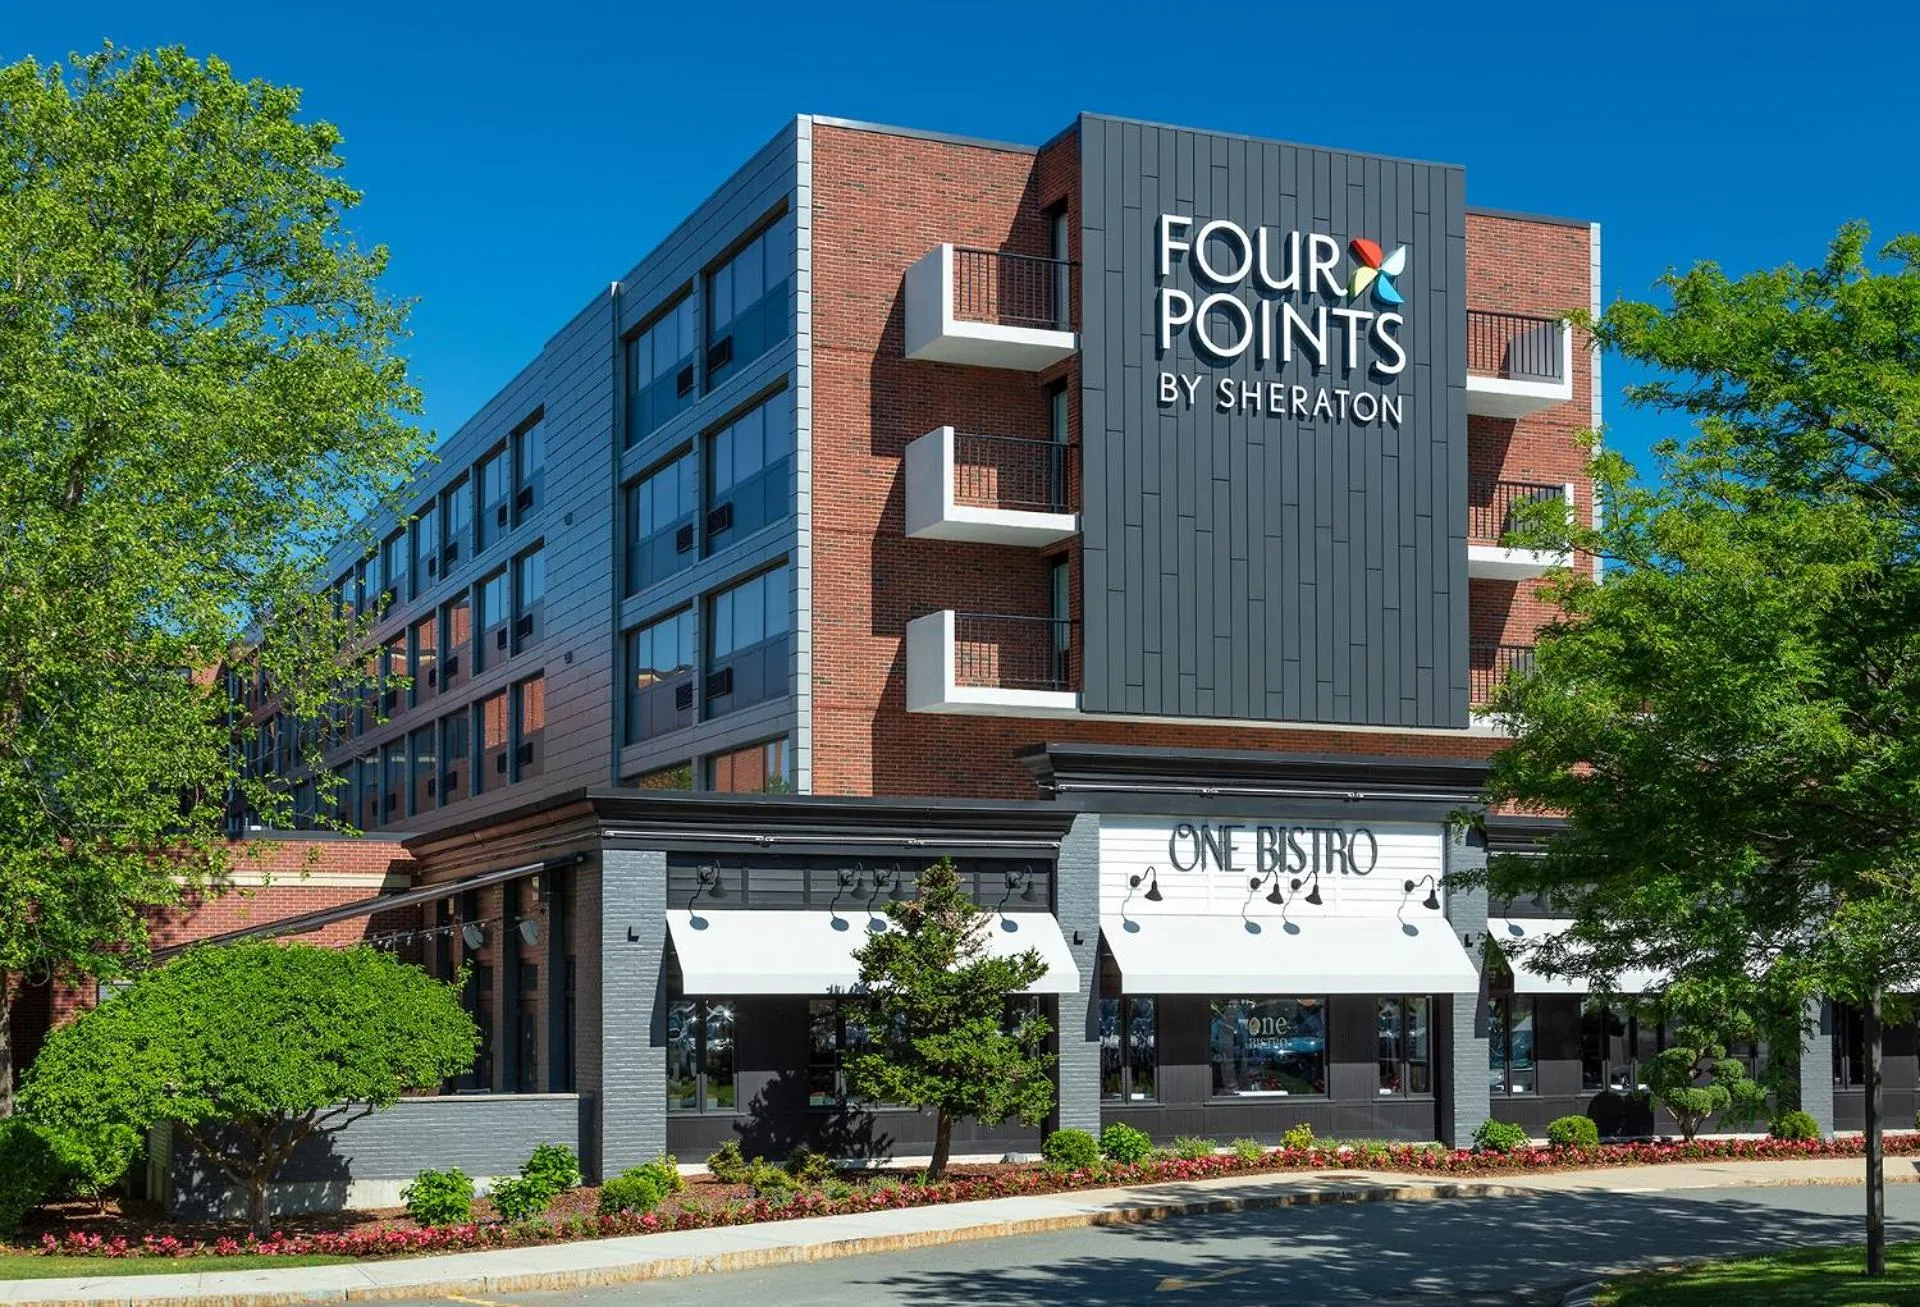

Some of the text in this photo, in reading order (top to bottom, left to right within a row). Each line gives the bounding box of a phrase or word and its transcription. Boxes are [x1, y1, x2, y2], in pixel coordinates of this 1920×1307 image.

[1160, 213, 1348, 297] FOUR
[1160, 287, 1407, 375] POINTS
[1160, 372, 1403, 424] BY SHERATON
[1169, 823, 1378, 876] ONE BISTRO
[1248, 1016, 1288, 1036] one
